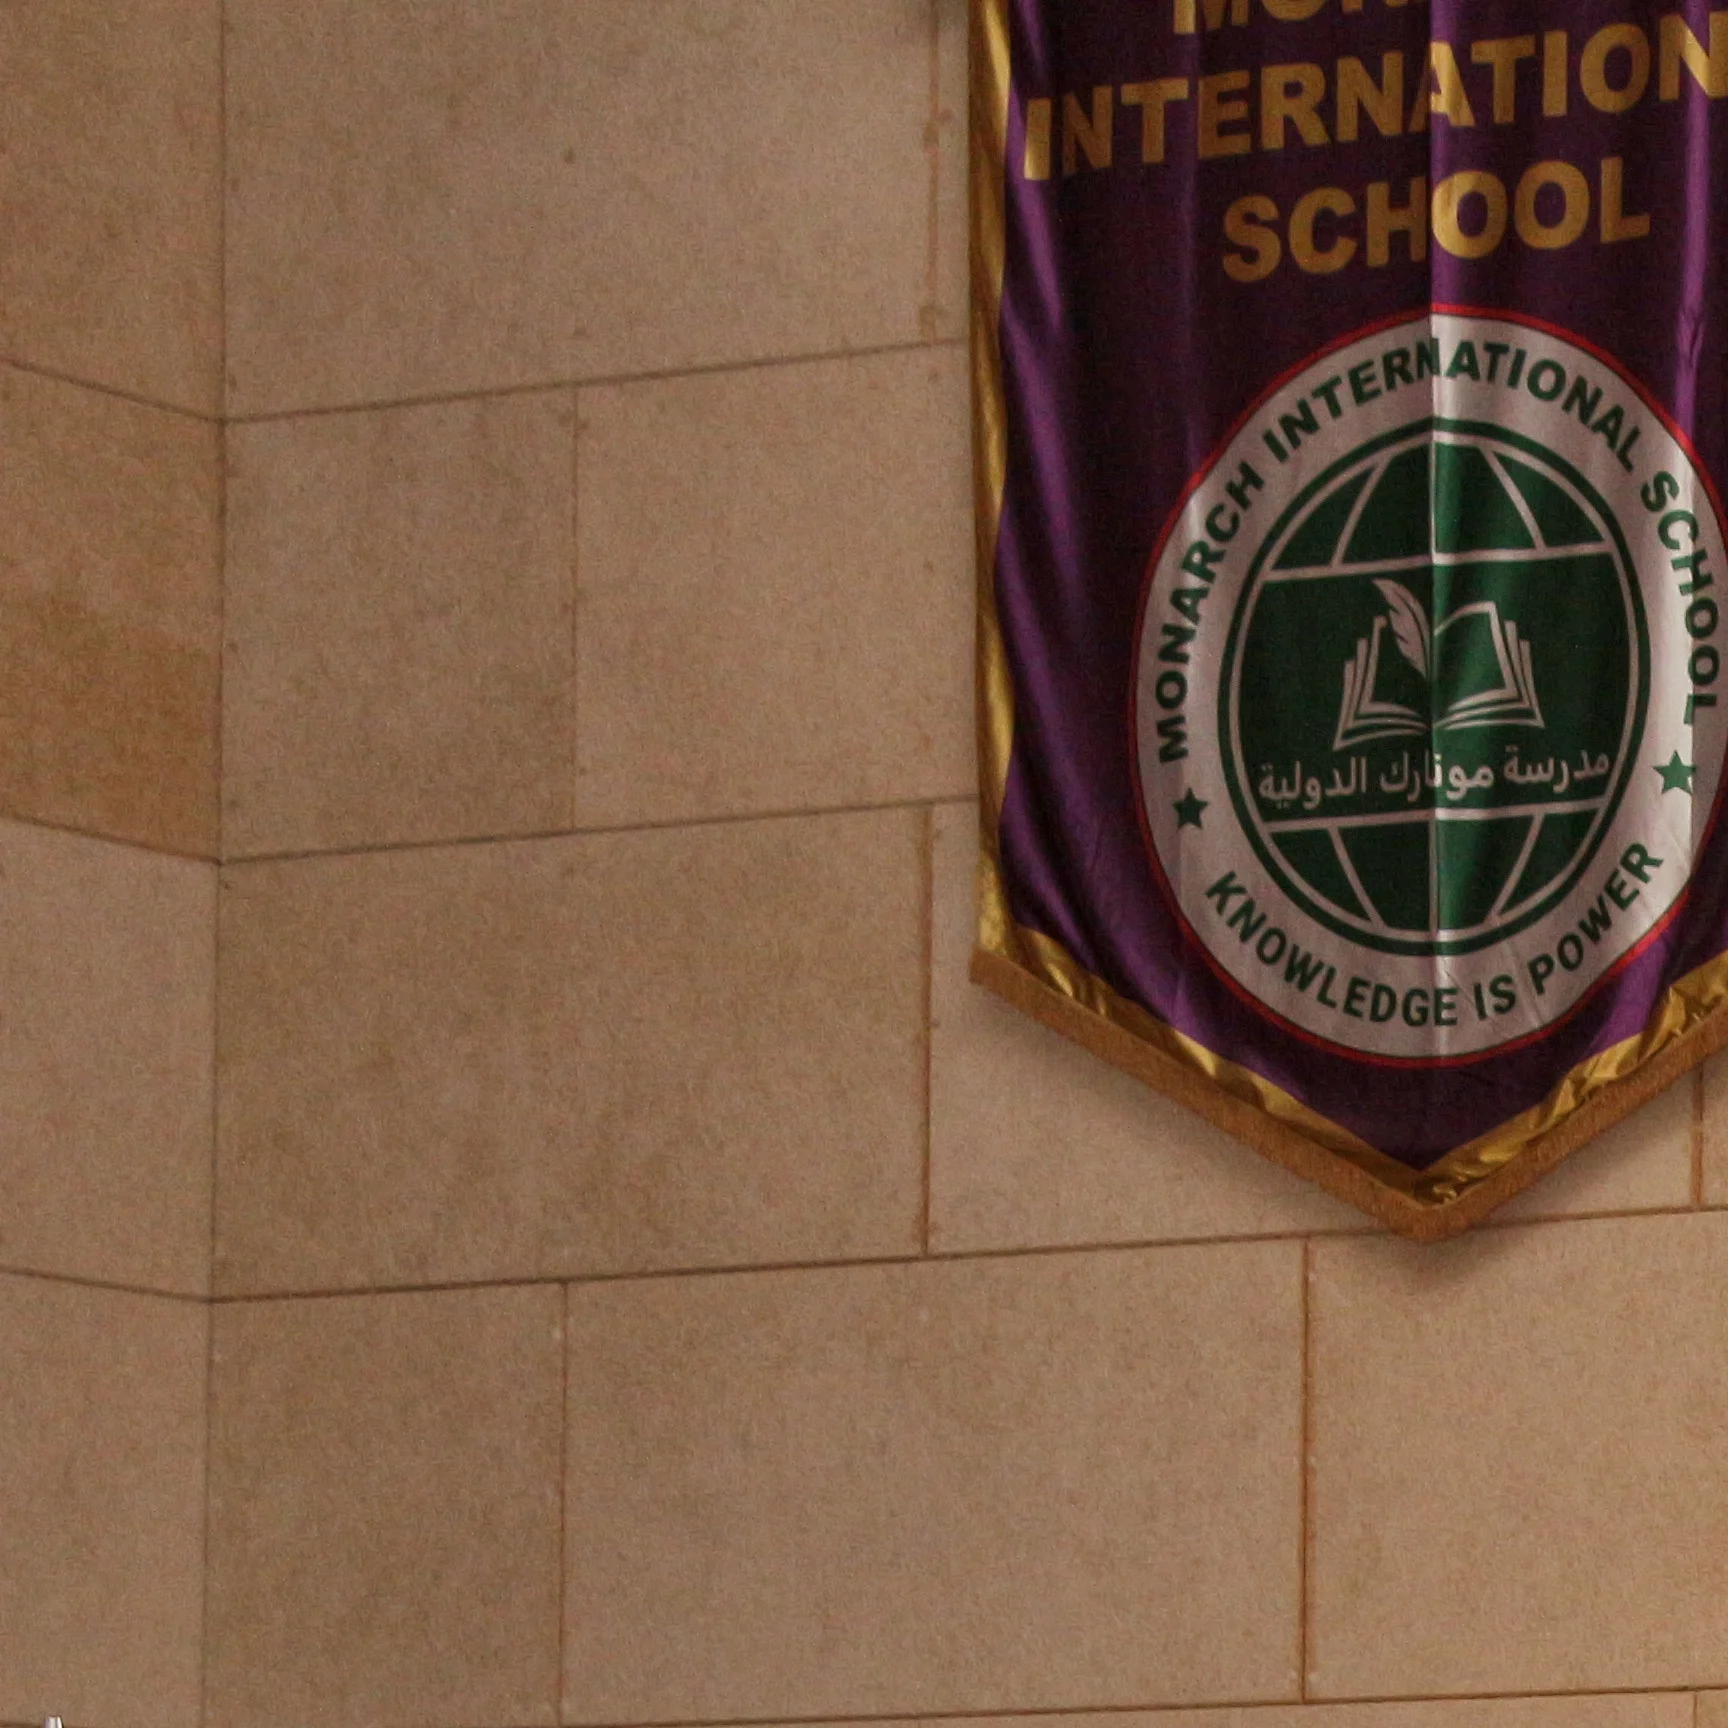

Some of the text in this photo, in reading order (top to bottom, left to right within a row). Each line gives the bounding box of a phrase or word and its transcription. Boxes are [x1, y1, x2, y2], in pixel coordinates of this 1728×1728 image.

[1222, 156, 1650, 283] SCHOOL
[1155, 338, 1720, 764] MONARCH INTERNATIONAL SCHOOL
[1258, 757, 1367, 810] الدولية
[1503, 746, 1610, 793] مدرسة
[1205, 842, 1664, 1027] KNOWLEDGE IS POWER
